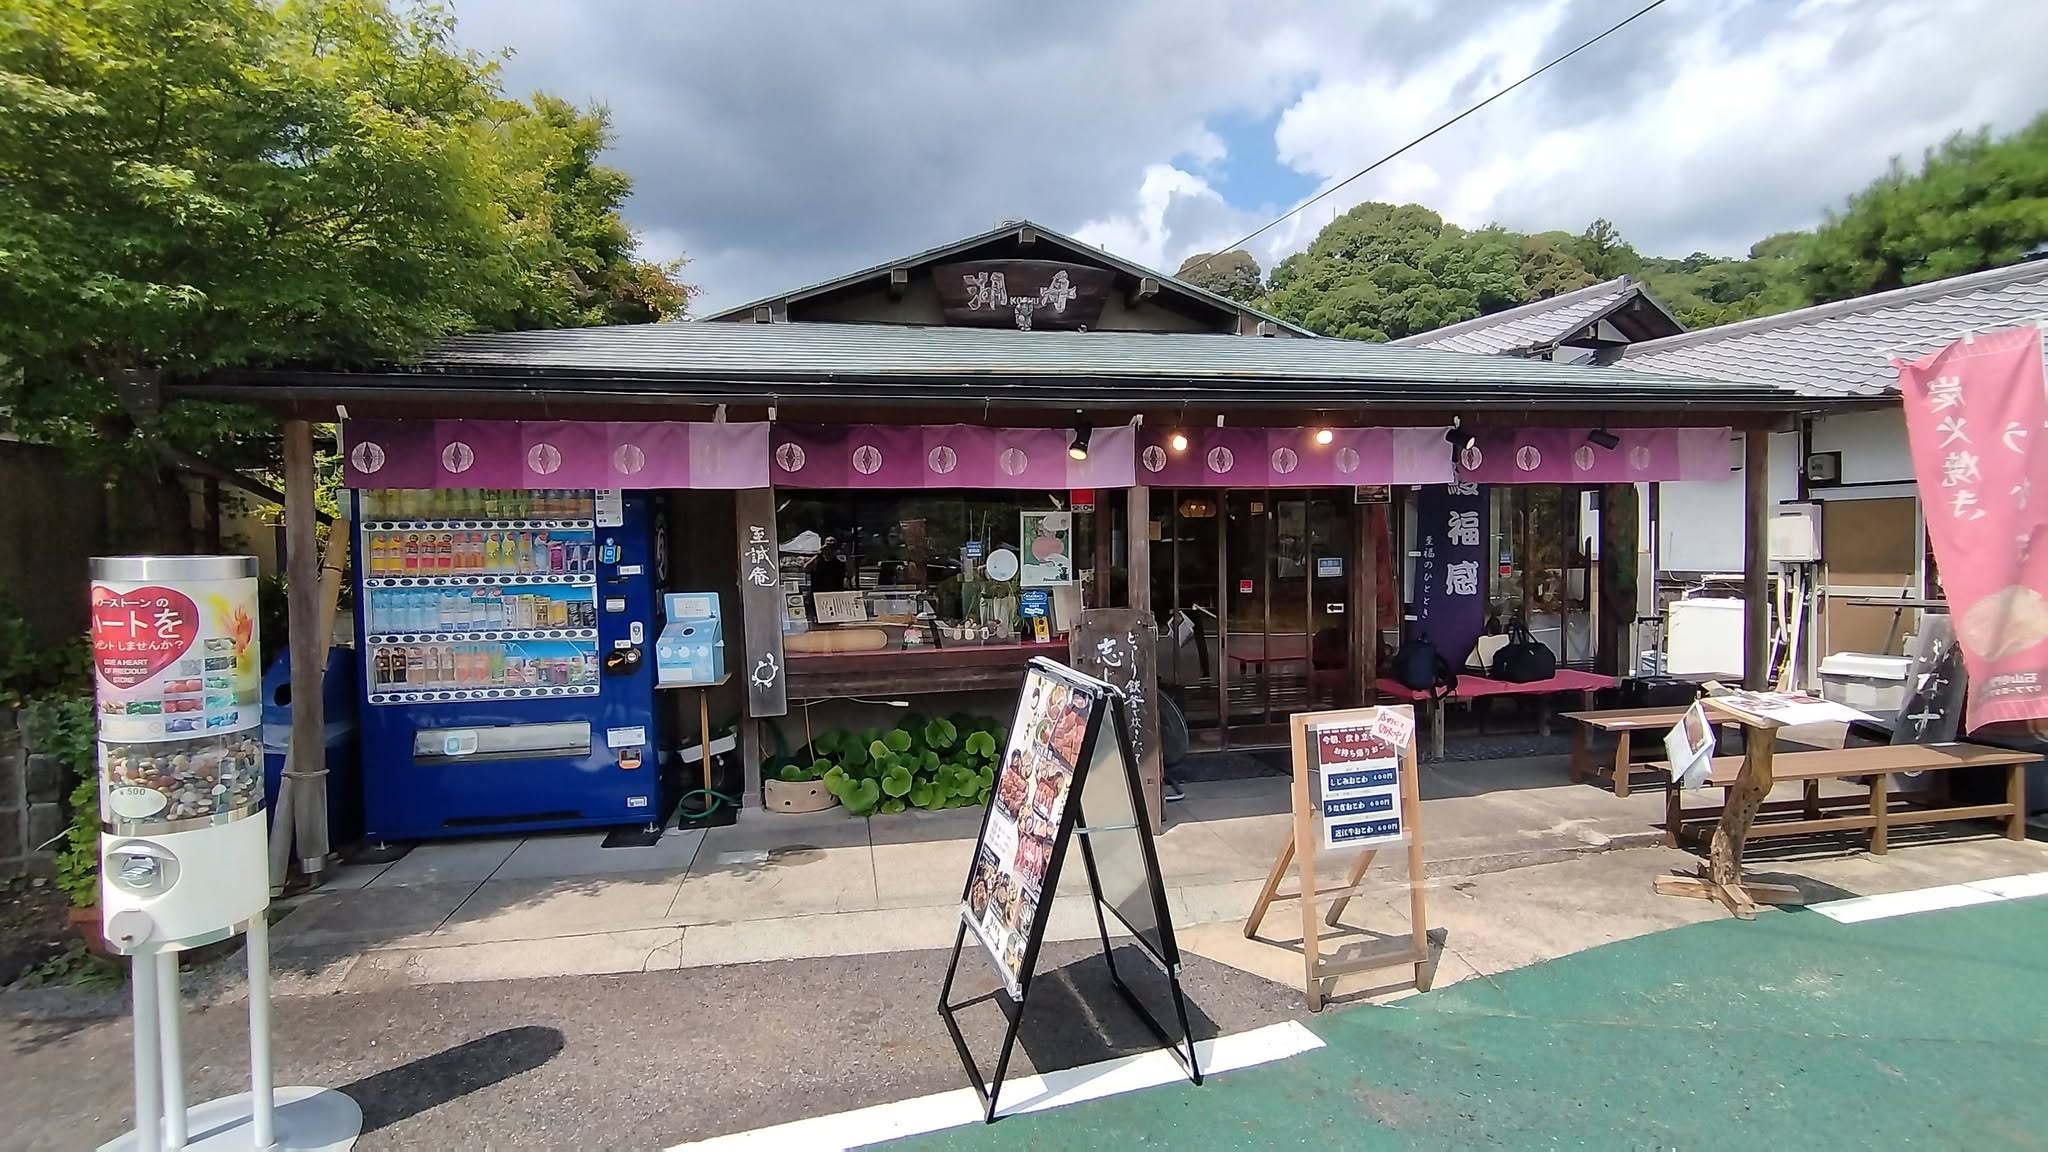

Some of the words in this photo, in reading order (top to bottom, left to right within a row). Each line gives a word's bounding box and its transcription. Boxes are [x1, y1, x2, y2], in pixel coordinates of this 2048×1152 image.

[745, 526, 777, 587] 至誠庵
[1422, 535, 1436, 619] 至福のひととき
[1330, 775, 1369, 786] しじみおこわ
[1327, 801, 1366, 813] うなぎおこわ
